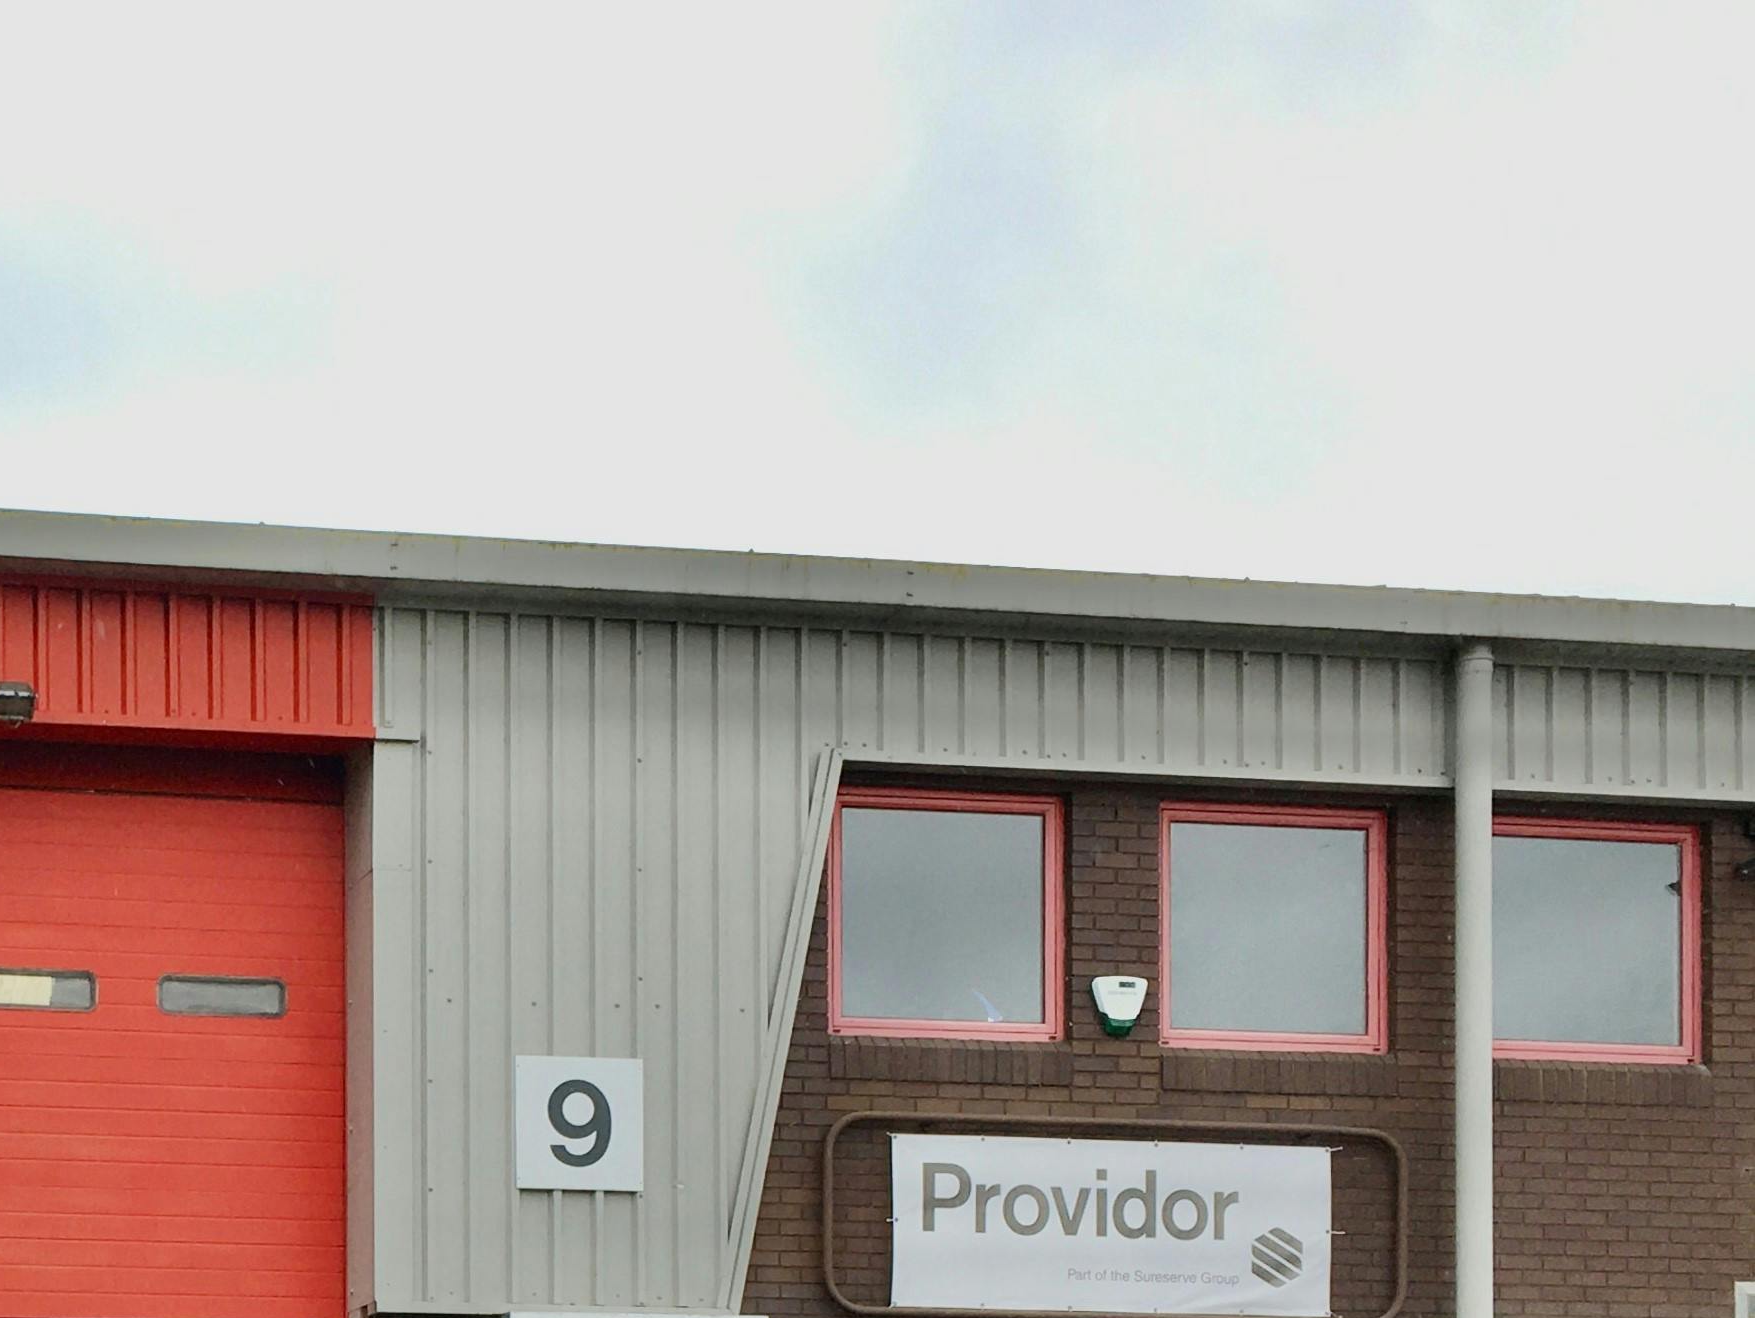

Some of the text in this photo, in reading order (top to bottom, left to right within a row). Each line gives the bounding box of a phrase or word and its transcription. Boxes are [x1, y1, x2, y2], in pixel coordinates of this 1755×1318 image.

[548, 1079, 612, 1167] 9
[922, 1162, 1239, 1241] Providor
[1067, 1268, 1240, 1288] Part of the Sureserve Group
